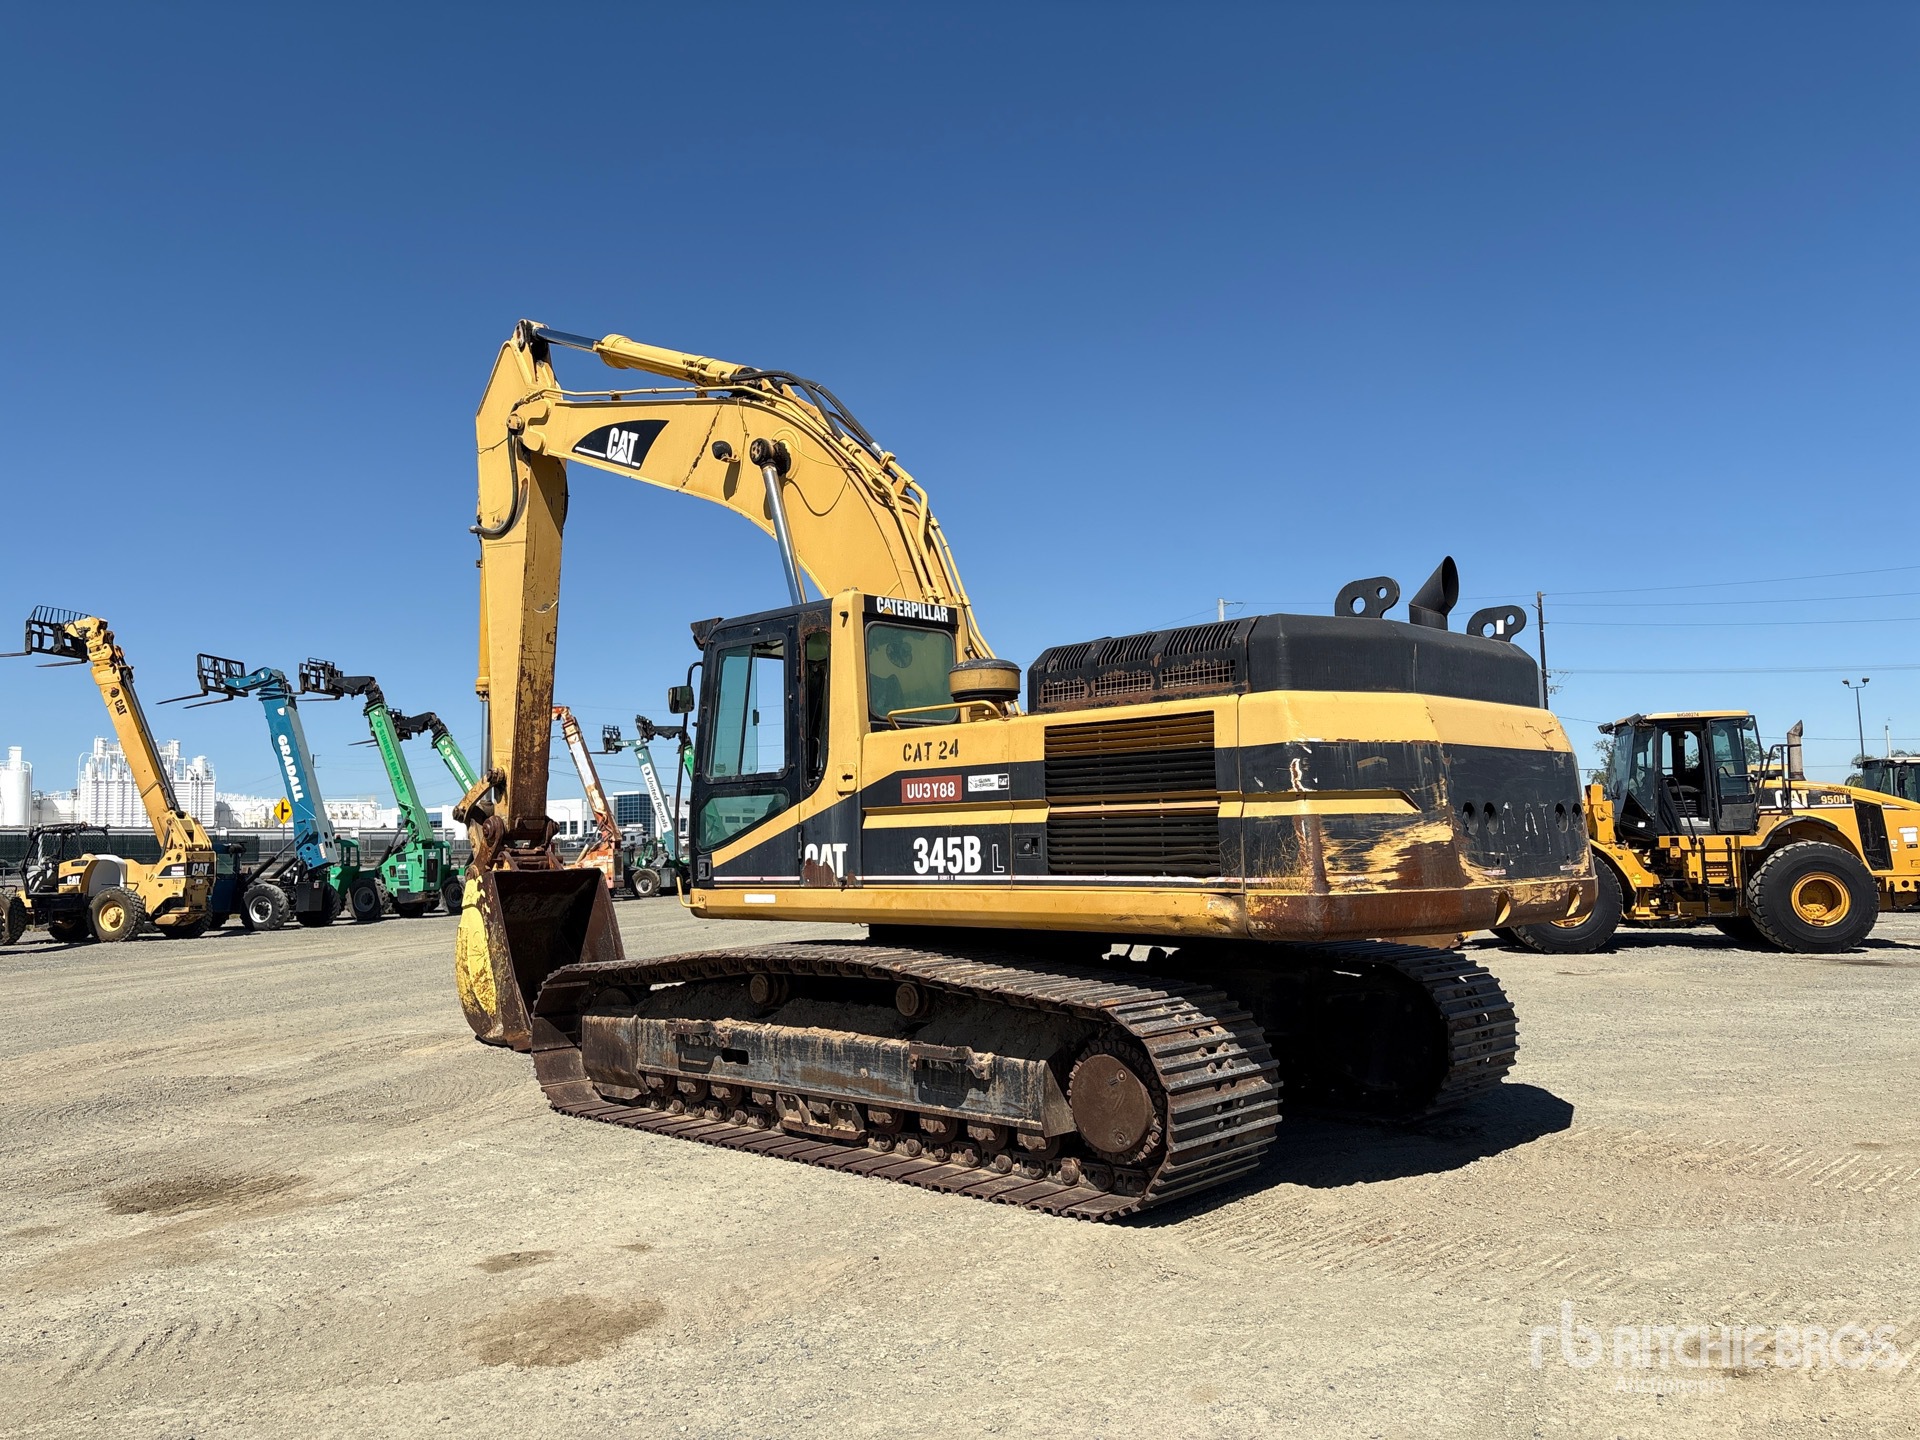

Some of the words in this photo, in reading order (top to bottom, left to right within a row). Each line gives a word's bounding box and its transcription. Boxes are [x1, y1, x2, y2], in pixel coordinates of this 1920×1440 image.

[607, 427, 640, 465] CAT
[876, 596, 949, 622] CATERPILLAR
[114, 699, 127, 716] CAT
[903, 742, 932, 763] CAT
[938, 739, 959, 760] 24
[277, 734, 304, 803] GRADALL
[906, 781, 956, 799] UU3Y88
[1821, 795, 1847, 805] 950H
[647, 777, 659, 801] United
[656, 802, 668, 828] Rentals
[913, 835, 982, 874] 345B
[991, 843, 1005, 873] L
[66, 875, 80, 885] CAT
[191, 863, 210, 876] CAT
